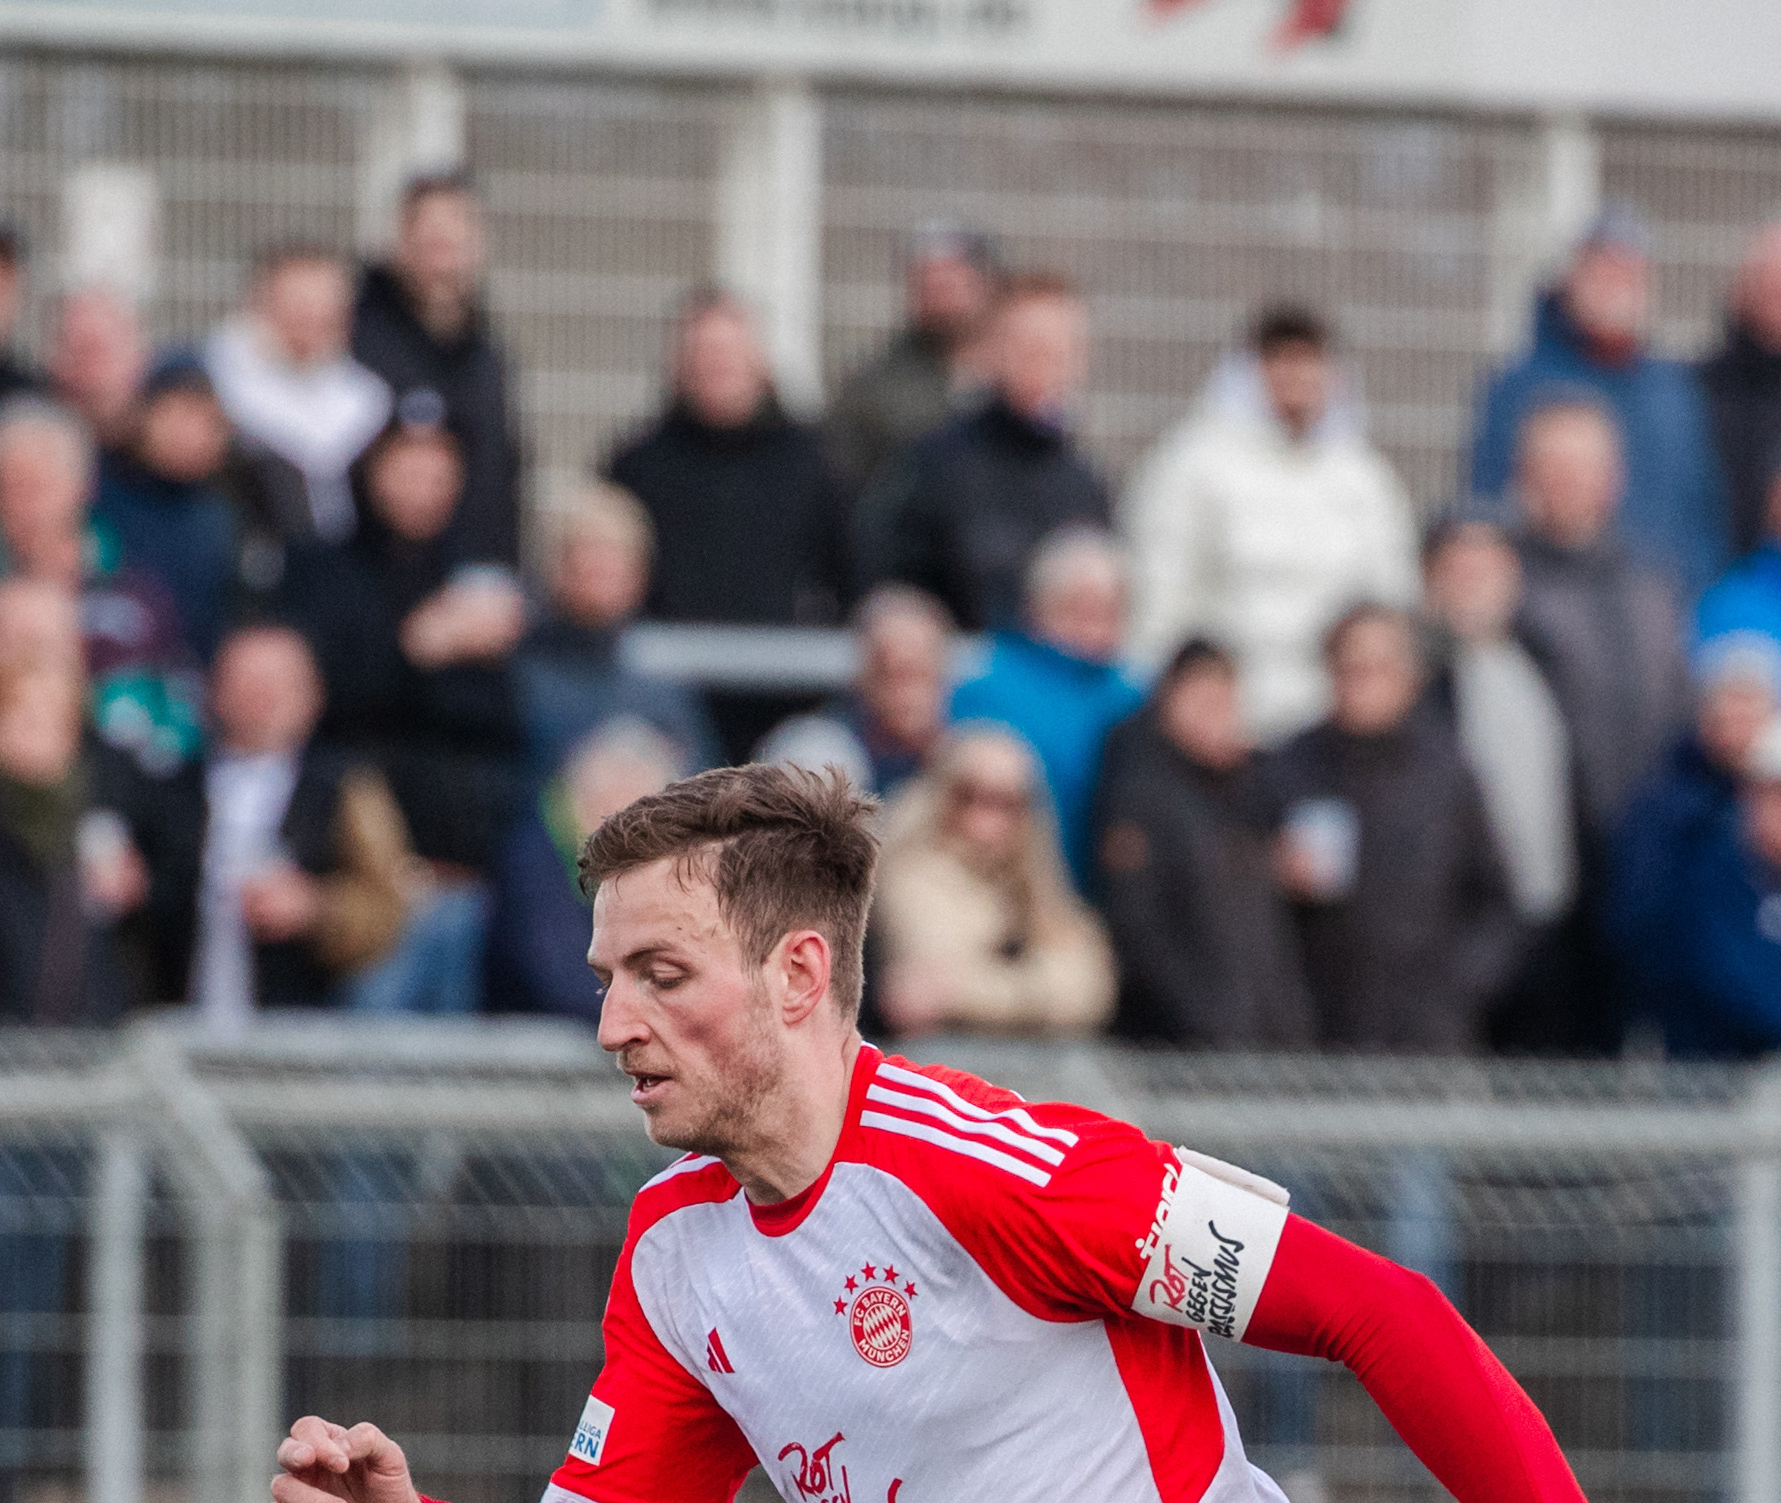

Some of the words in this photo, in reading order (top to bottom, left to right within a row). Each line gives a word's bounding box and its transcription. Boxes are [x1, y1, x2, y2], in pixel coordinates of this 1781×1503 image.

[853, 1307, 865, 1327] FC
[861, 1292, 907, 1317] BAYERN
[777, 1431, 846, 1503] ROT
